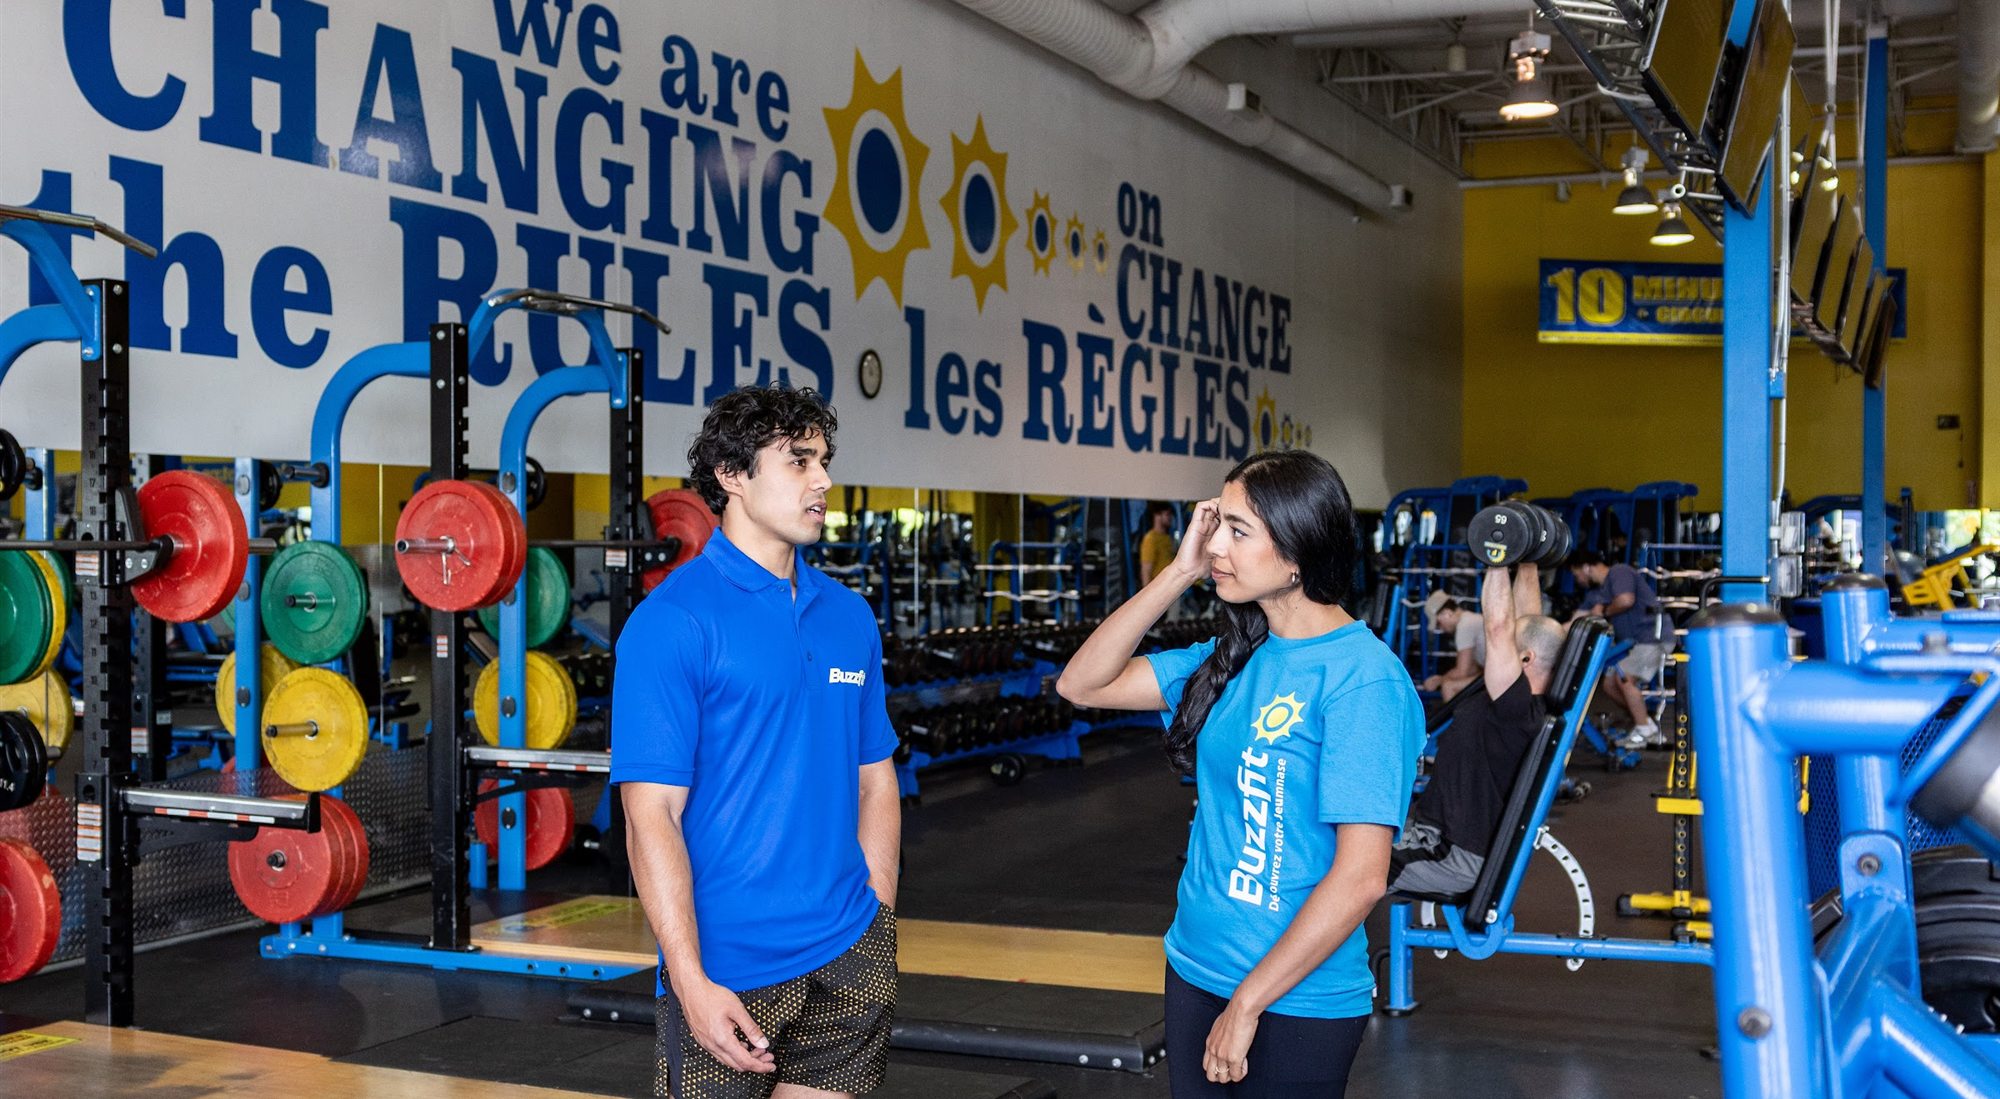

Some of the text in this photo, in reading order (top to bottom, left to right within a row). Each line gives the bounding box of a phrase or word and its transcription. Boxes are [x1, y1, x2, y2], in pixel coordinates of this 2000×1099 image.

[62, 0, 820, 277] CHANGING
[493, 0, 790, 142] we are
[23, 154, 834, 407] the RULES
[1117, 181, 1163, 248] on
[1117, 243, 1292, 374] CHANGE
[1547, 267, 1628, 326] 10
[904, 303, 1252, 463] les RÈGLES
[1228, 746, 1272, 906] Buzzfit
[1268, 757, 1287, 912] Déouvrez votre Jeumnase
